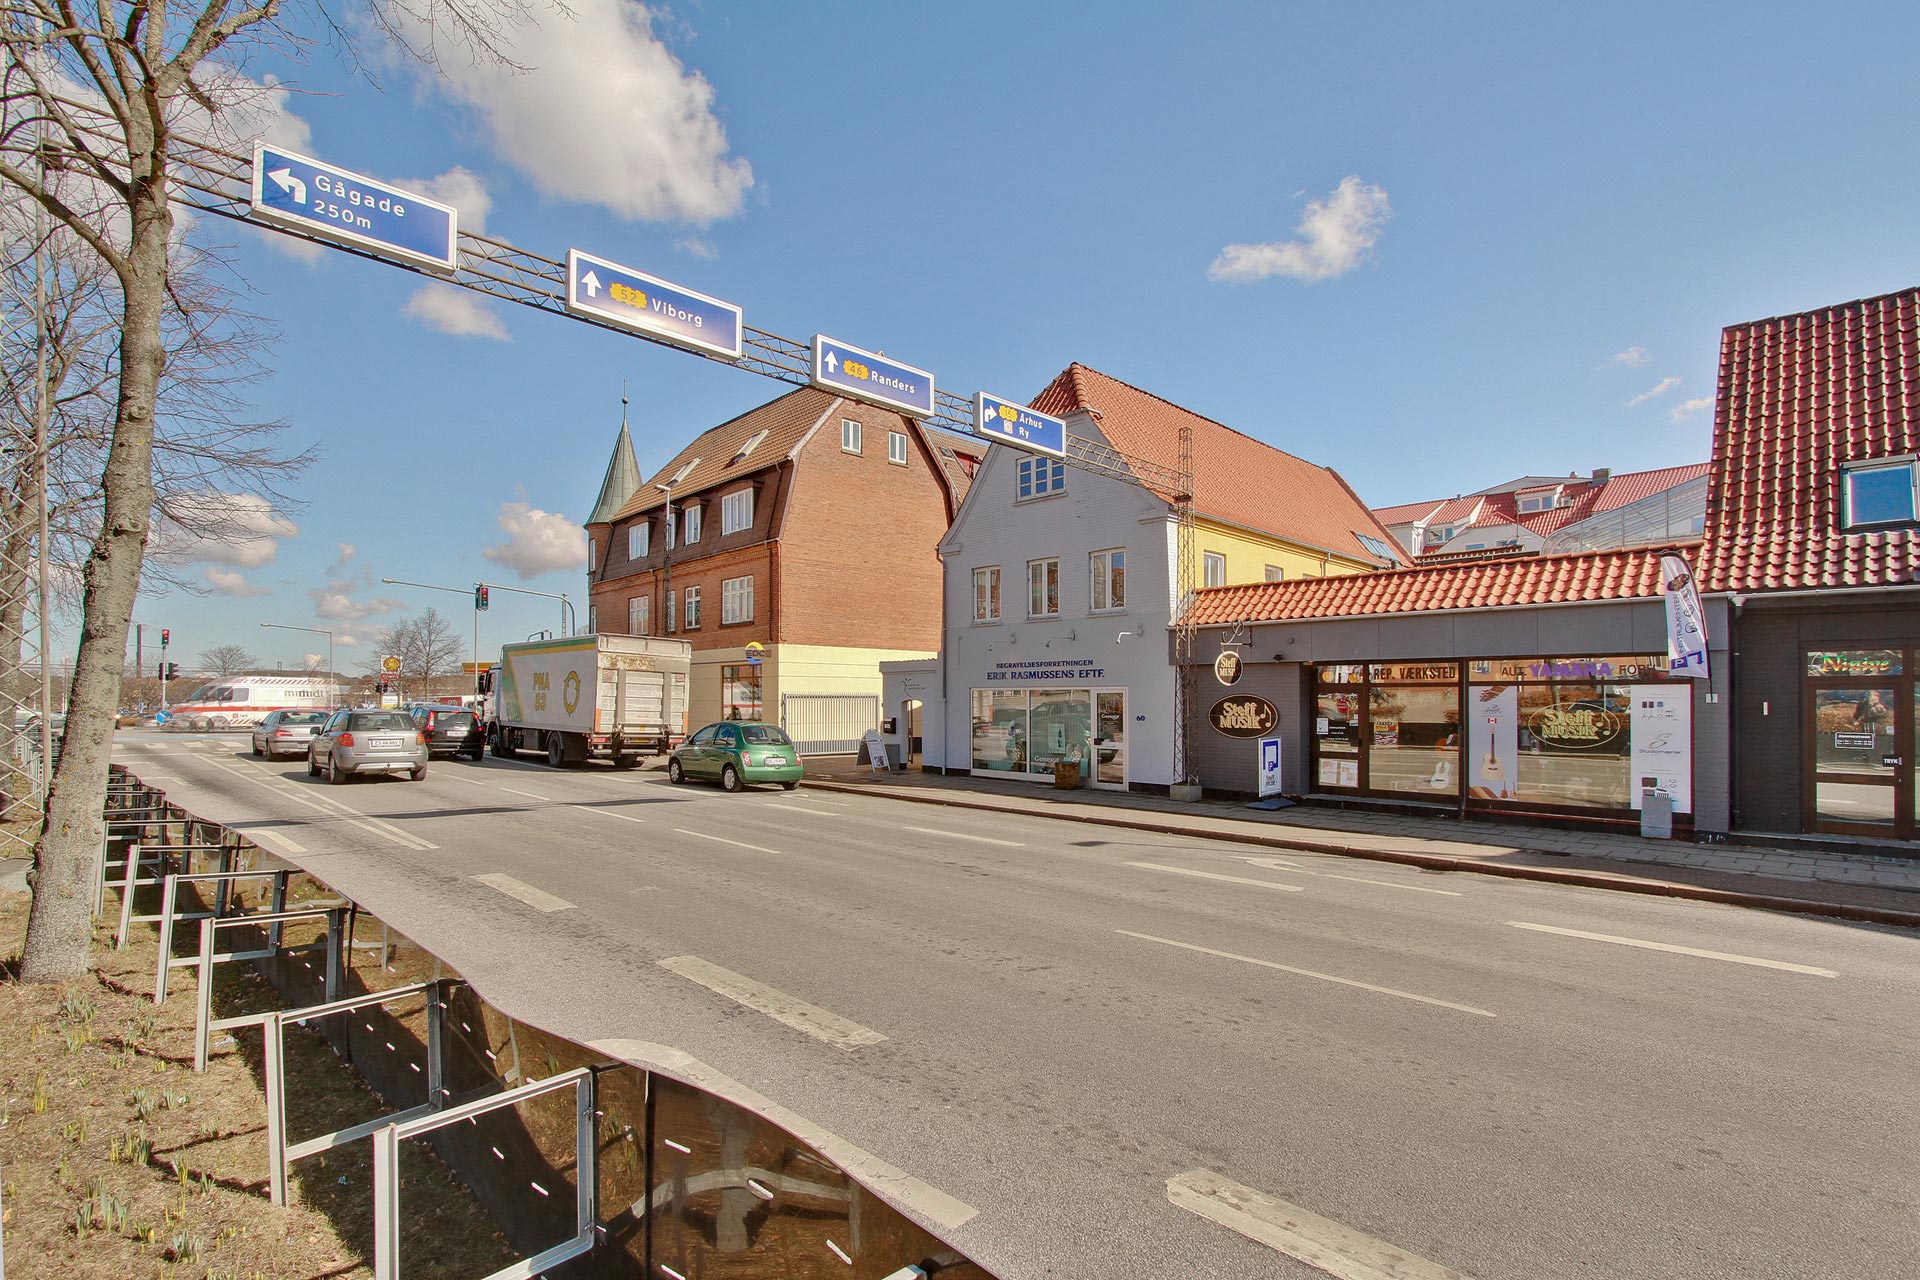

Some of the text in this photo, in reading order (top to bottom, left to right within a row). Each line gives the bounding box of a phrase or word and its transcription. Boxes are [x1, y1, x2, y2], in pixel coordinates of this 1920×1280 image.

[314, 174, 406, 217] Gågade
[313, 199, 372, 229] 250m
[620, 289, 703, 328] 52 Viborg
[849, 364, 916, 394] 46 Randers
[1018, 426, 1030, 439] Ry
[996, 660, 1094, 669] BEGRAVELSESFORRETNINGEN
[1220, 656, 1237, 668] Steff
[1823, 655, 1891, 673] Ninive
[987, 669, 1105, 680] ERIK RASMUSSENS EFTF.
[1374, 666, 1456, 680] REP. VÆRKSTED
[1222, 702, 1258, 717] Steff
[1219, 714, 1262, 729] MUSIK
[1544, 709, 1595, 726] Steff
[1541, 724, 1600, 739] MUSIK
